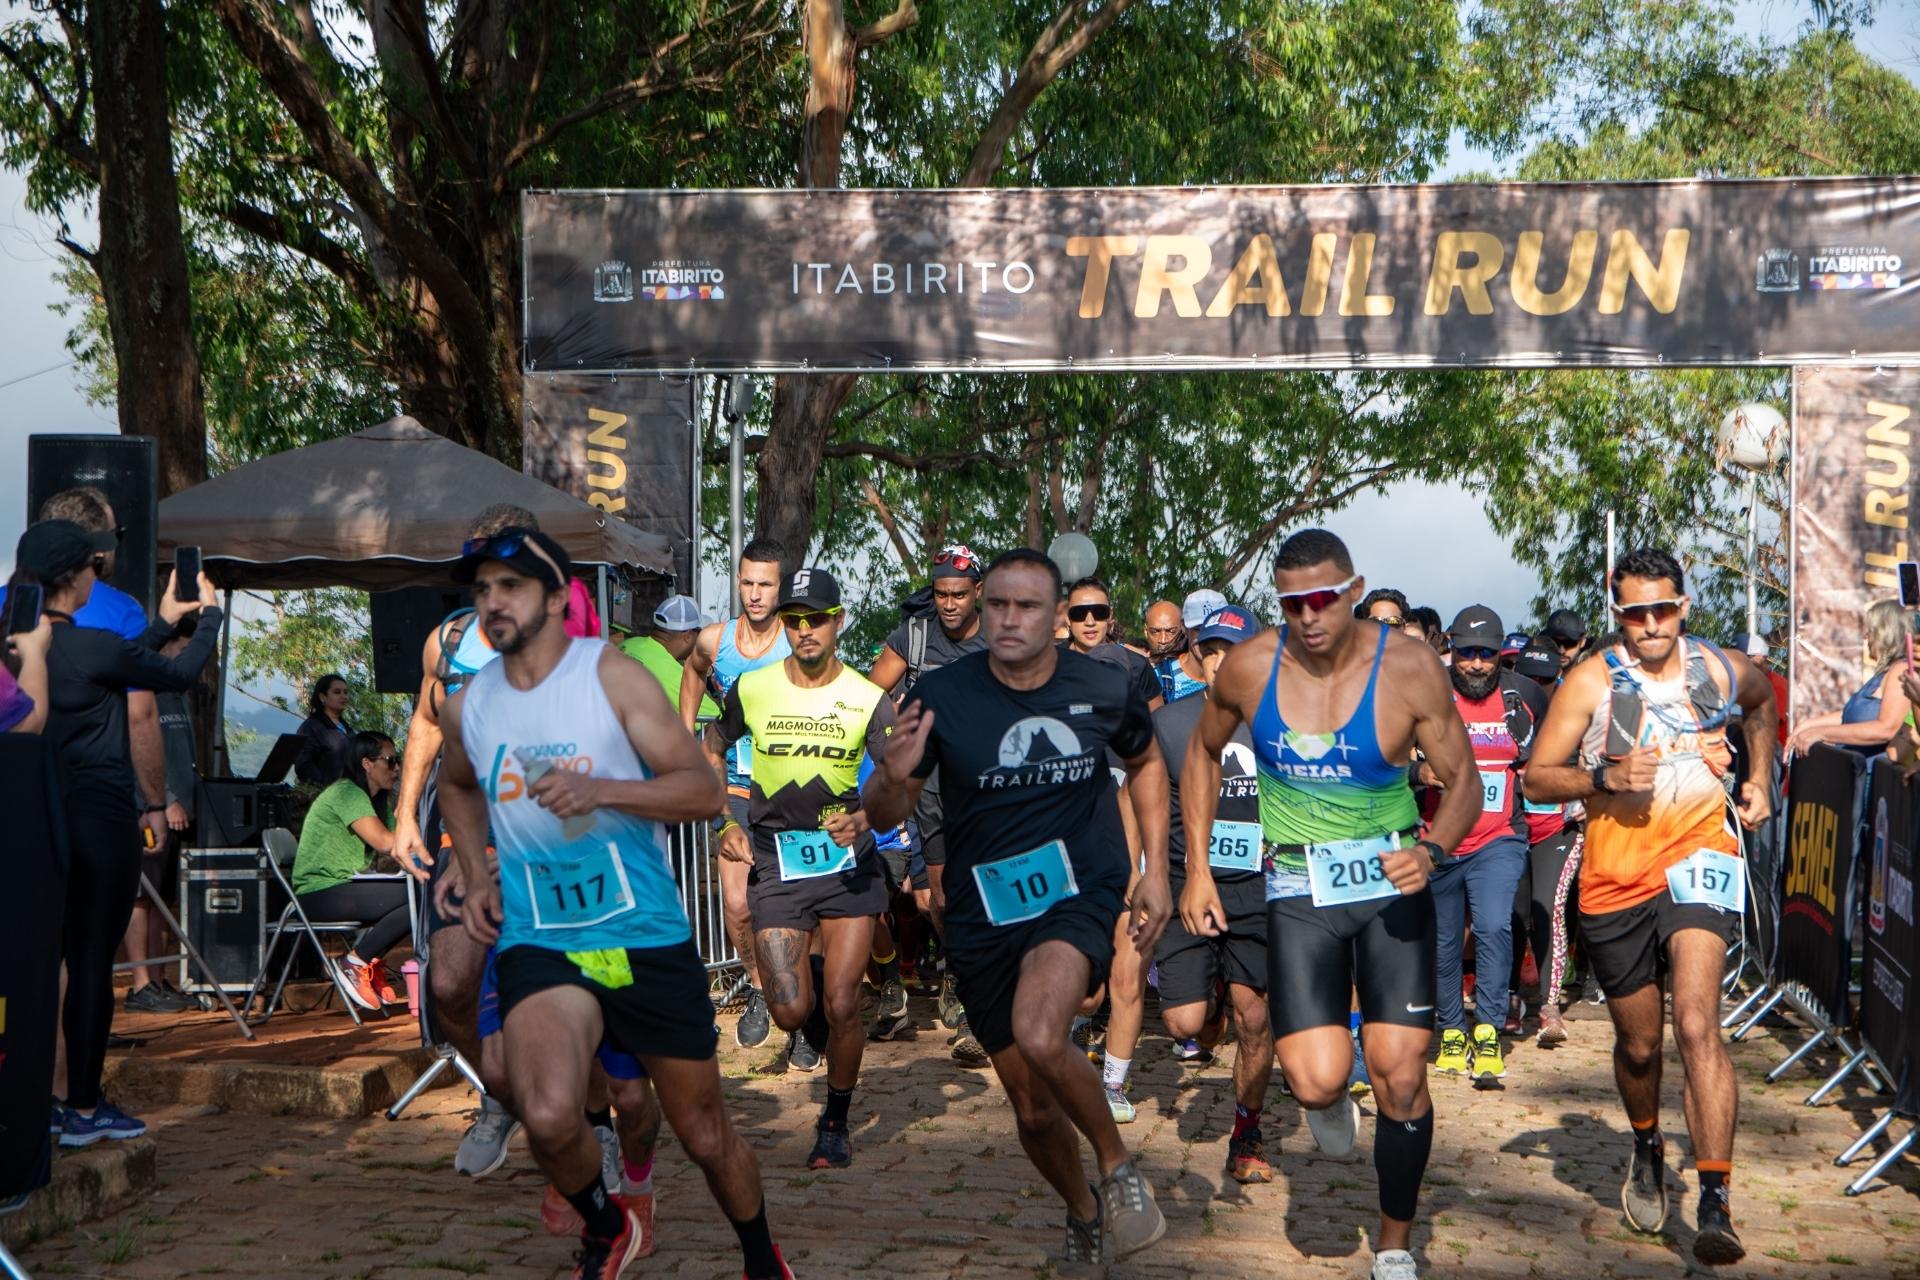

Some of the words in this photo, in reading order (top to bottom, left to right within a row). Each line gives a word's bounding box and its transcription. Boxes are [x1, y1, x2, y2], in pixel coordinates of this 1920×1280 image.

[1810, 255, 1902, 273] ITABIRITO
[1821, 247, 1887, 256] PREFEITURA
[642, 269, 724, 284] ITABIRITO
[793, 263, 1035, 294] ITABIRITO
[1065, 232, 1395, 319] TRAIL
[1423, 228, 1691, 316] RUN
[587, 407, 627, 521] RUN
[1865, 400, 1911, 529] RUN
[766, 721, 834, 733] MAGMOTOS
[1040, 757, 1095, 771] ITABIRITO
[1275, 762, 1352, 777] MEIAS
[801, 842, 830, 864] 91
[1786, 801, 1838, 916] SEMEL
[1329, 857, 1386, 888] 203
[1685, 867, 1730, 893] 157
[550, 872, 604, 911] 117
[1009, 872, 1048, 904] 10
